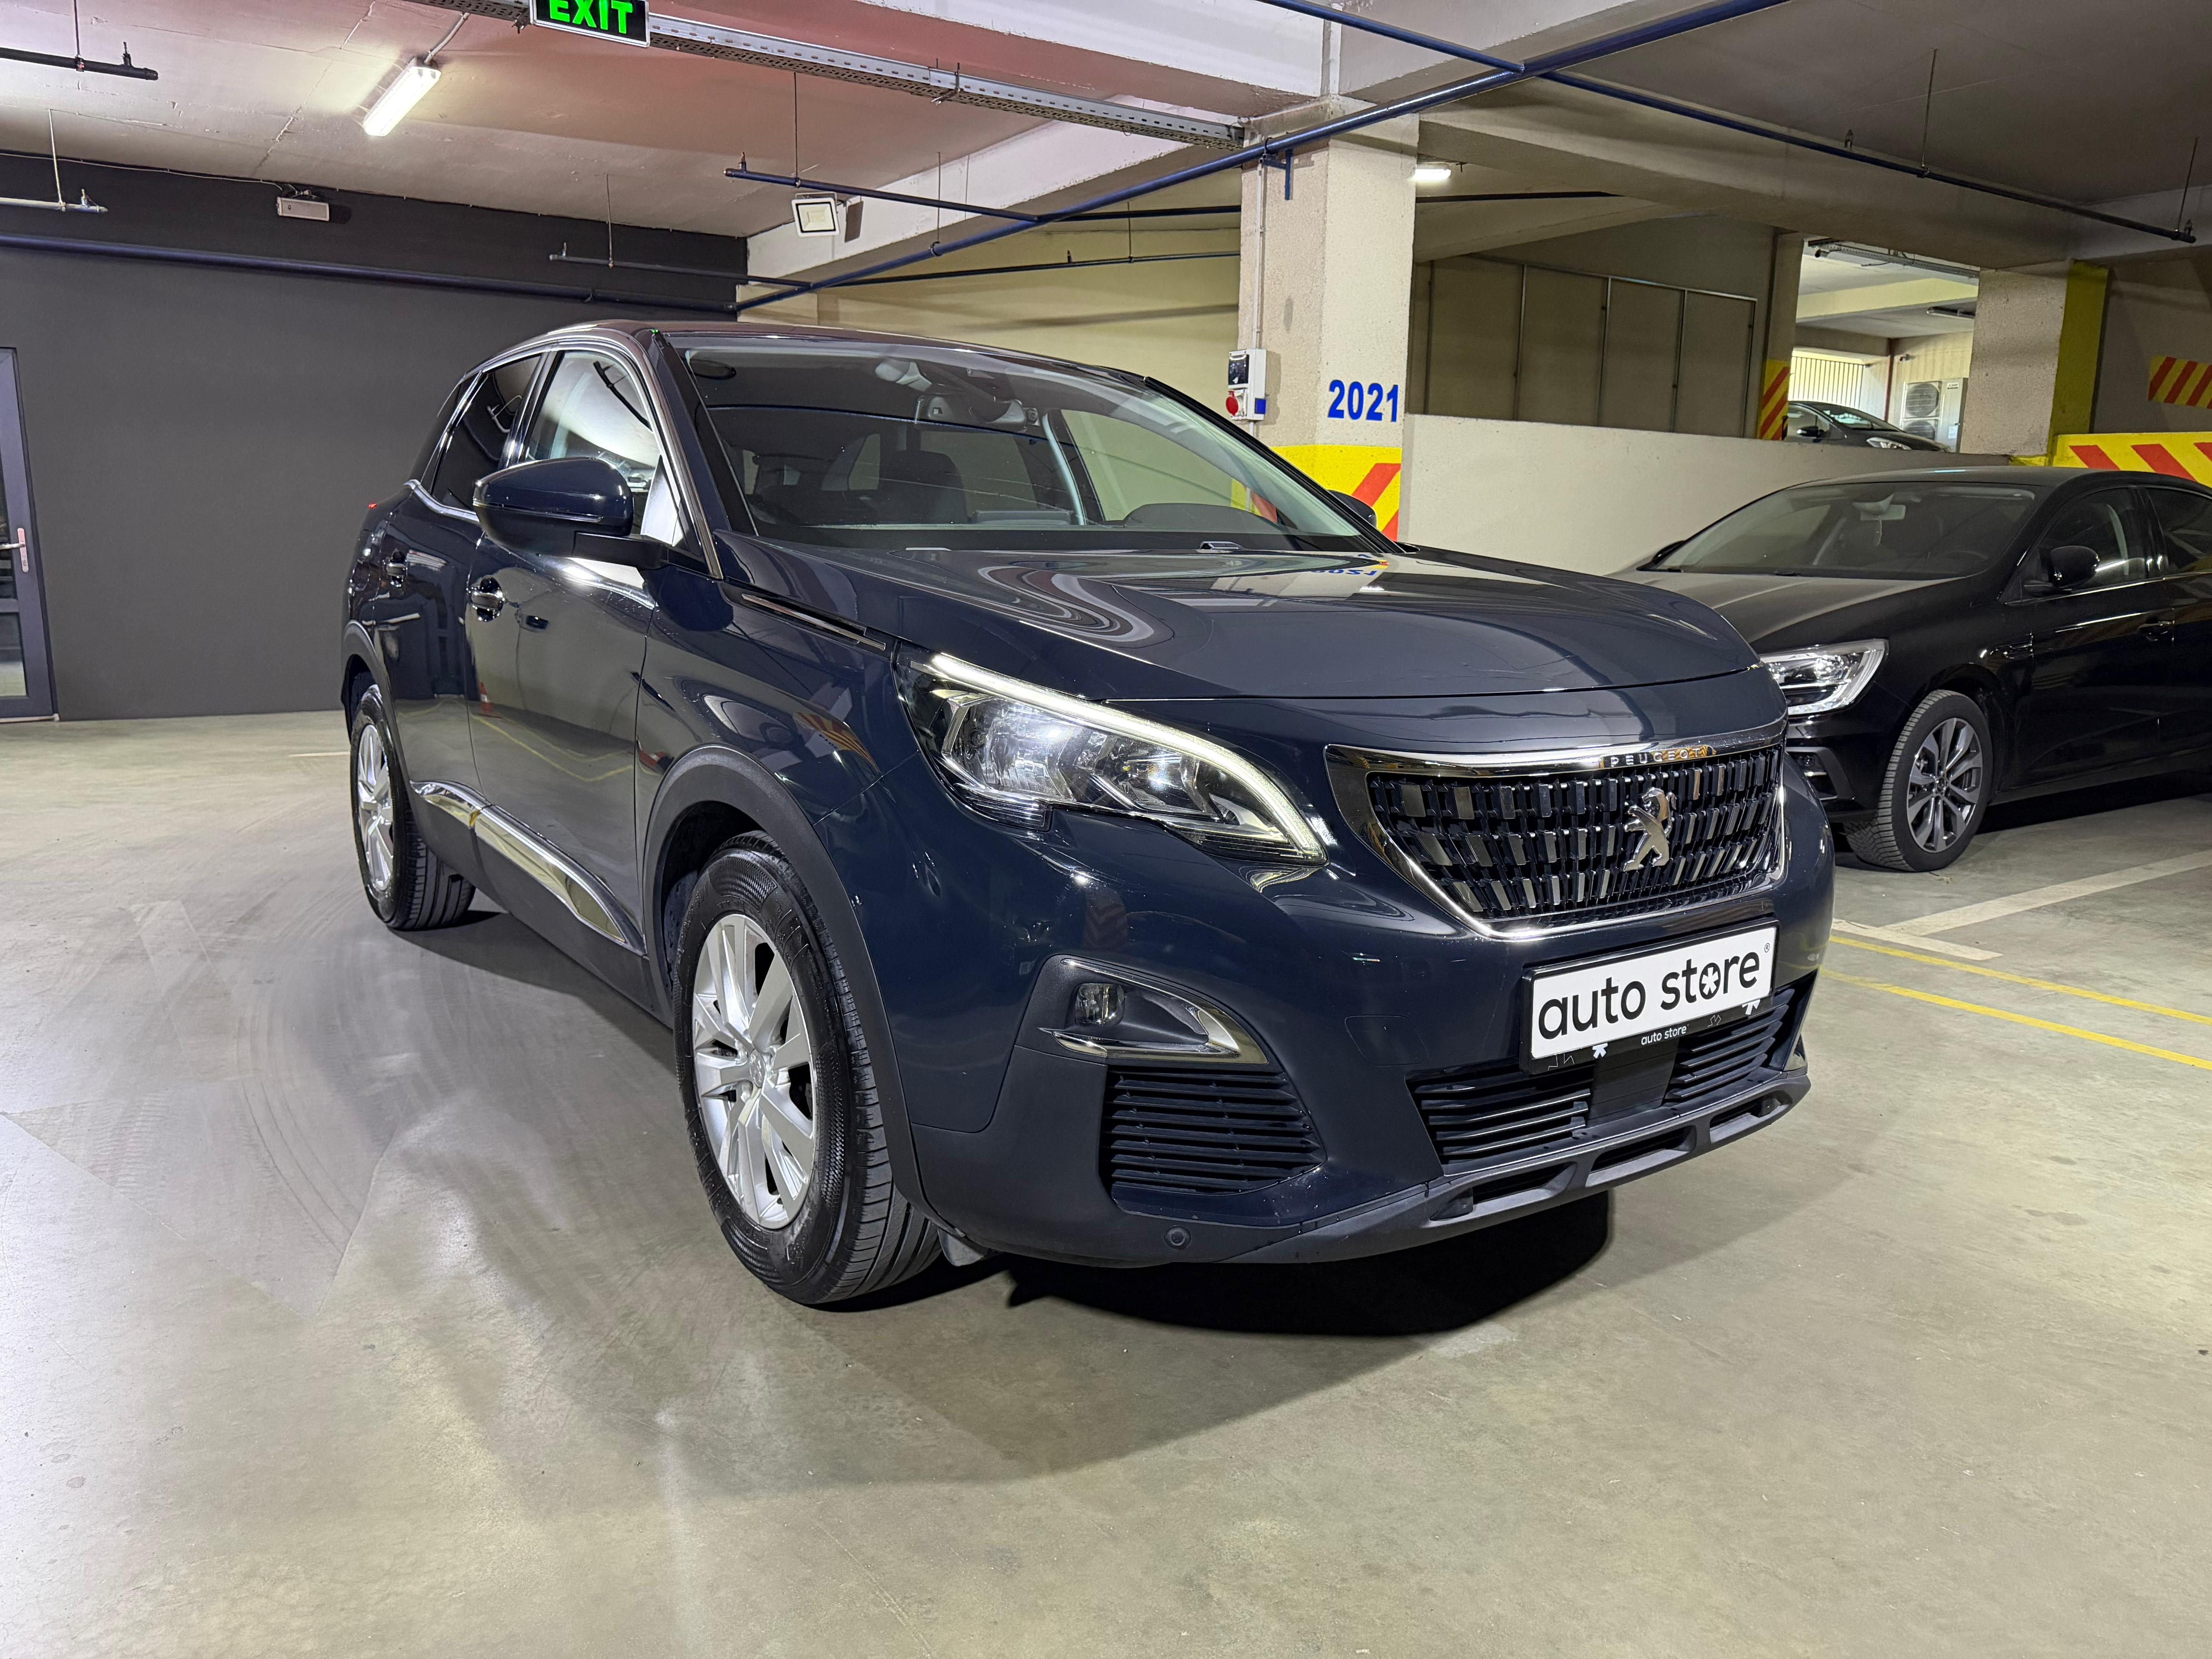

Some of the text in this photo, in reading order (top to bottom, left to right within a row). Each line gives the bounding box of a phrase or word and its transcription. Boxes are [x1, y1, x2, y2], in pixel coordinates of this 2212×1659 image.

[550, 0, 633, 34] EXIT
[1328, 379, 1398, 422] 2021
[1611, 748, 1700, 767] PEUGEOT
[1538, 977, 1646, 1039] auto
[1641, 1026, 1687, 1046] auto store
